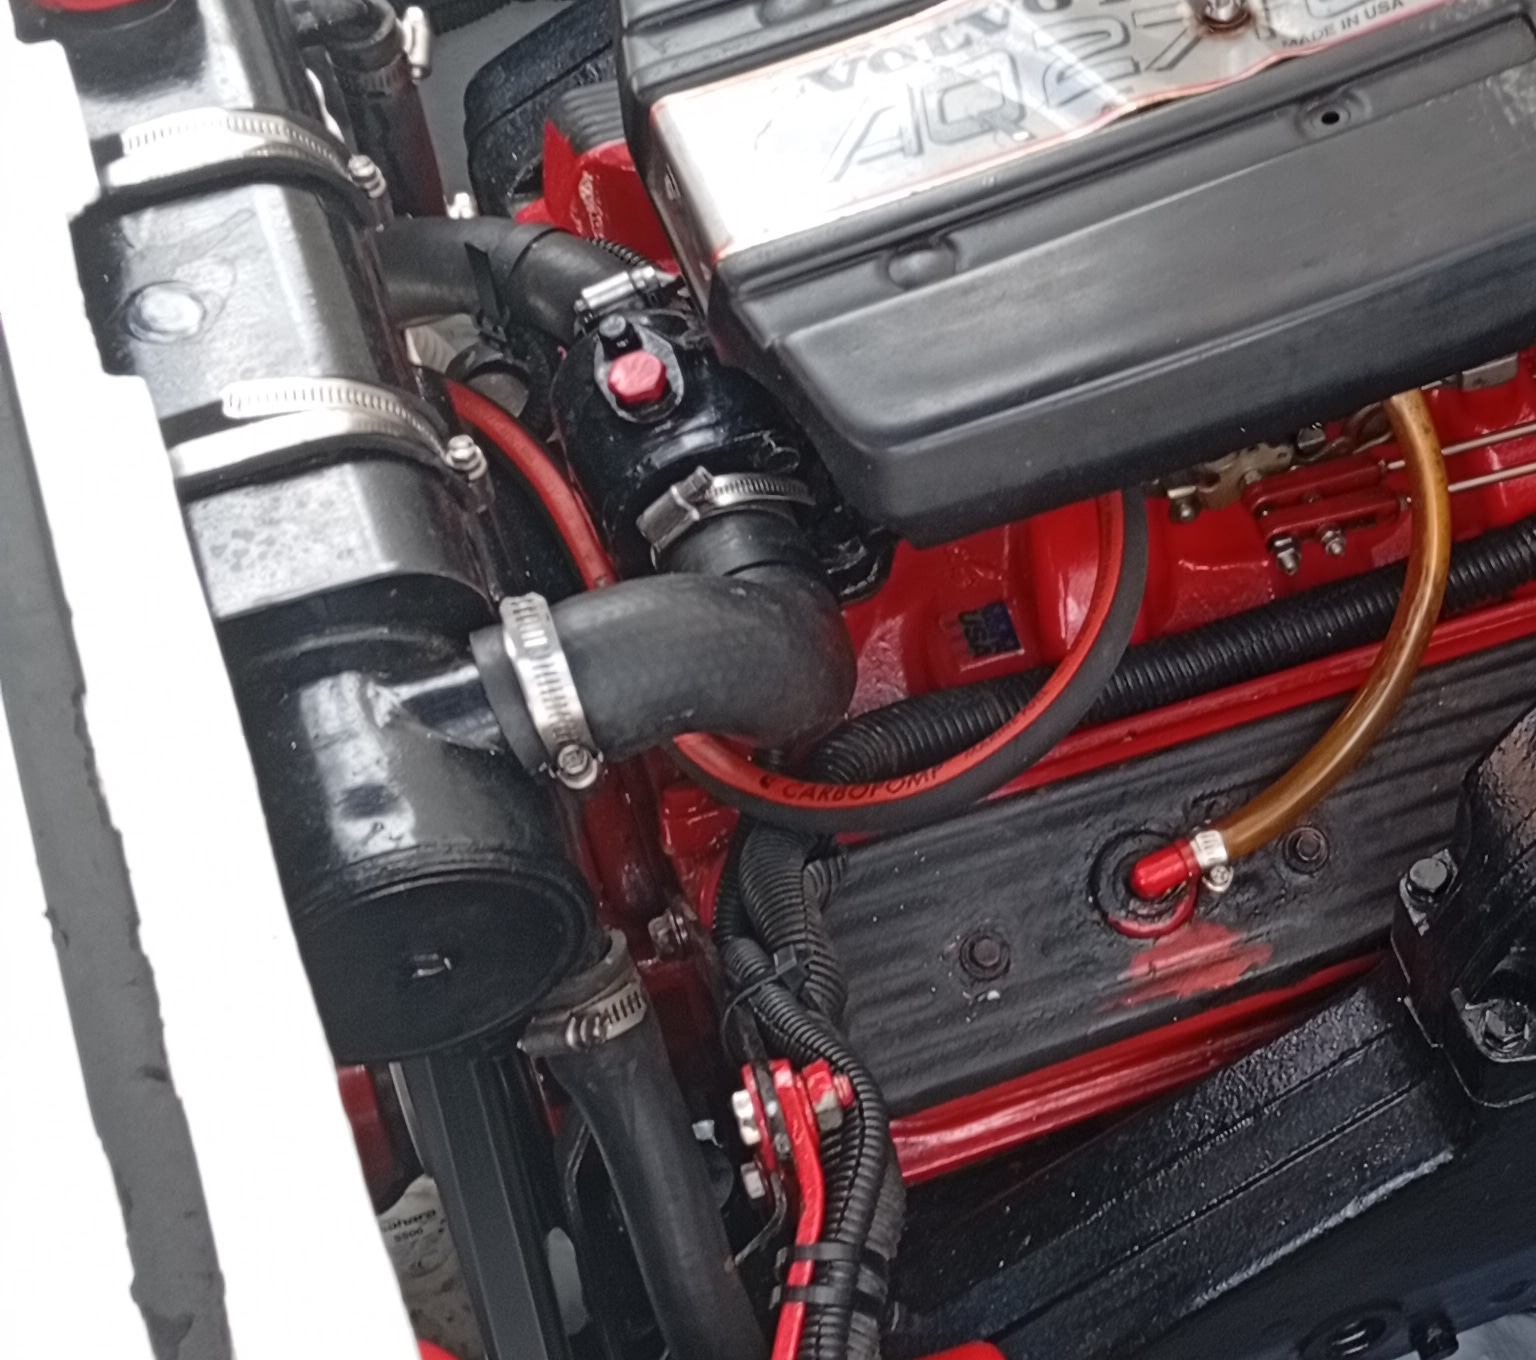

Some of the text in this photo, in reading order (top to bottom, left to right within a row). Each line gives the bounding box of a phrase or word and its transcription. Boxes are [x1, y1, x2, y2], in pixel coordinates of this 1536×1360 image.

[1281, 23, 1336, 50] MADE
[1340, 14, 1361, 31] IN
[782, 763, 944, 802] CARBOPOMP
